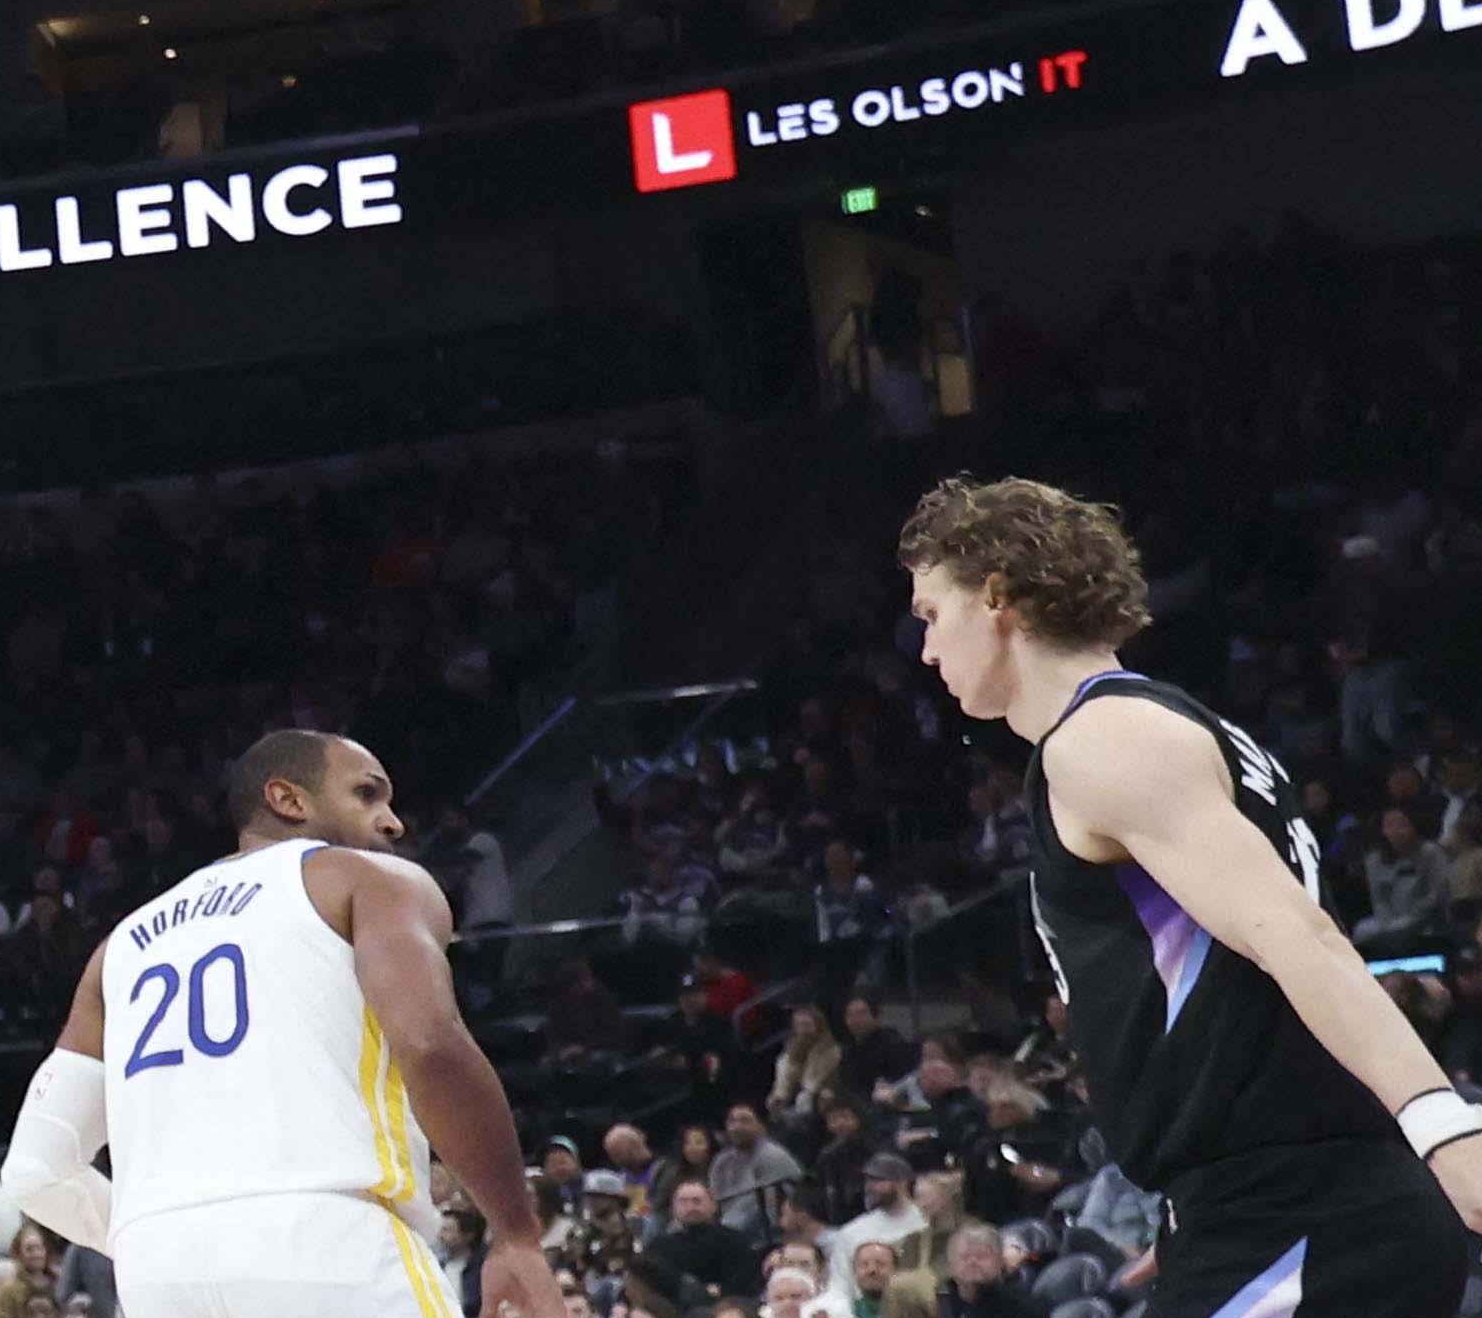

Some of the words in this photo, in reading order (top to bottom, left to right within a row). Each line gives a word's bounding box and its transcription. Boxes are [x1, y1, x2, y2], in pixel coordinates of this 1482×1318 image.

[652, 113, 712, 174] L
[747, 99, 840, 146] LES
[852, 62, 1024, 127] OLSON
[1039, 51, 1087, 93] IT
[129, 881, 263, 951] HORFORD
[124, 942, 250, 1080] 20
